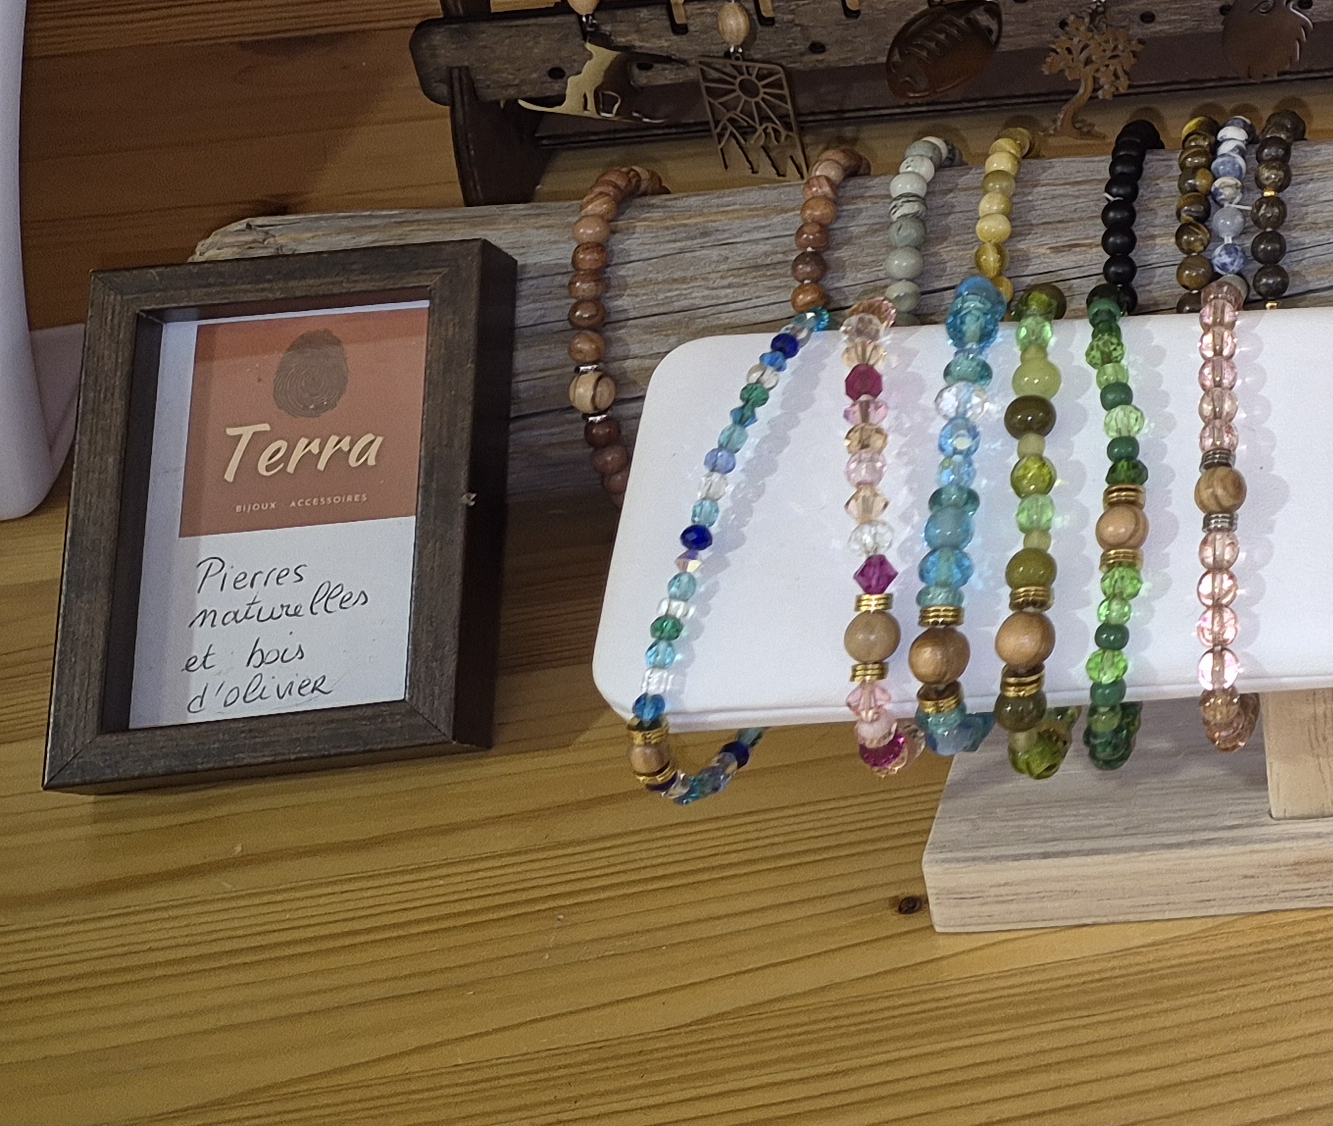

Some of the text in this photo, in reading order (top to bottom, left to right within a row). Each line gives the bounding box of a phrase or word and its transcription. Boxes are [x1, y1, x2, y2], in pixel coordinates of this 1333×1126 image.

[222, 422, 386, 484] Terra
[234, 493, 369, 514] BIJOUX ACCESSOIRES
[195, 555, 309, 596] Pierres
[188, 579, 370, 631] naturelles
[181, 630, 307, 674] et bois
[186, 673, 334, 716] d'olivier
